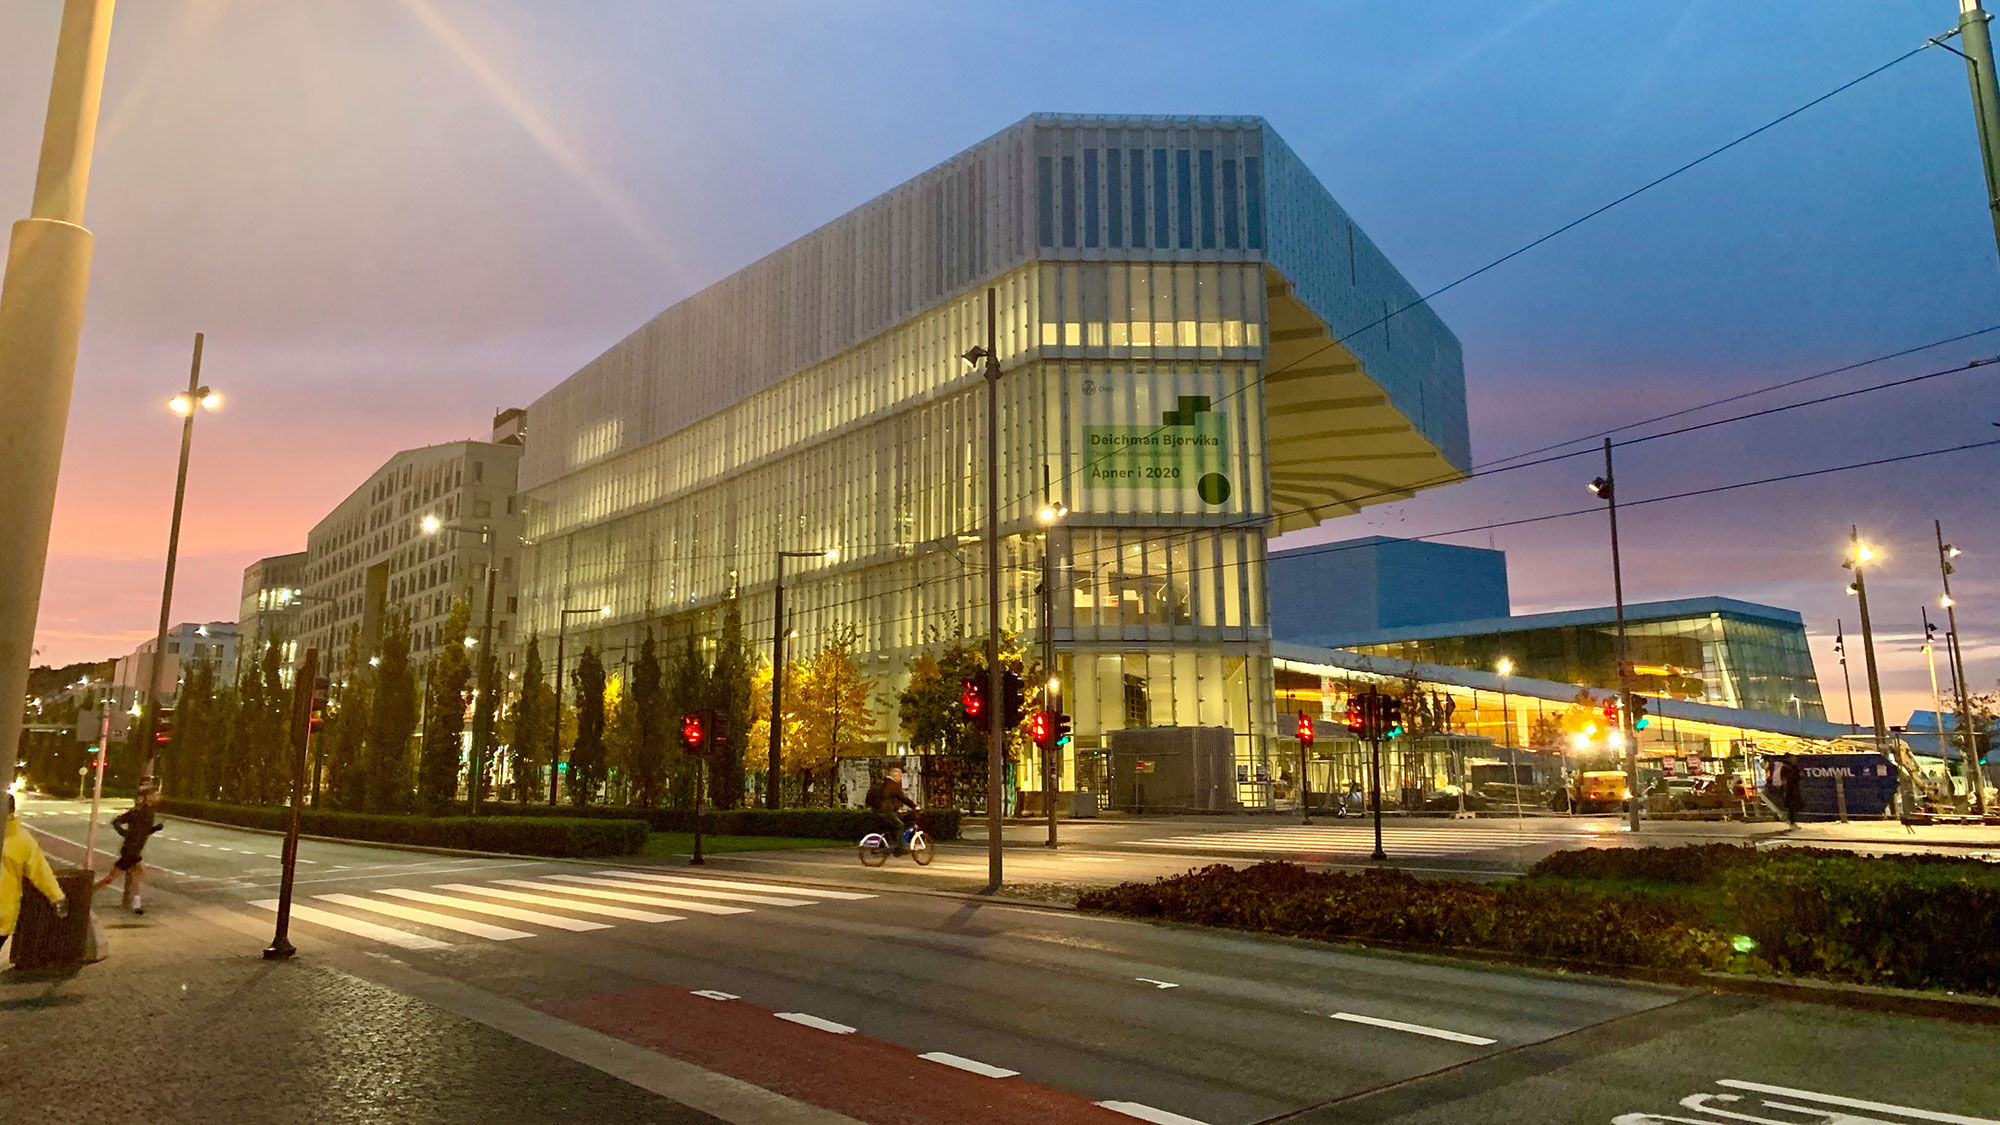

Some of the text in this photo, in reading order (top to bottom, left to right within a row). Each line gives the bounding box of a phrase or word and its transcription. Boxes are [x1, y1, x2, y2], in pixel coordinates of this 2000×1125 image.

[1091, 434, 1159, 446] Deichman
[1091, 464, 1180, 481] Åpner i 2020
[1803, 767, 1856, 778] TOMWIL
